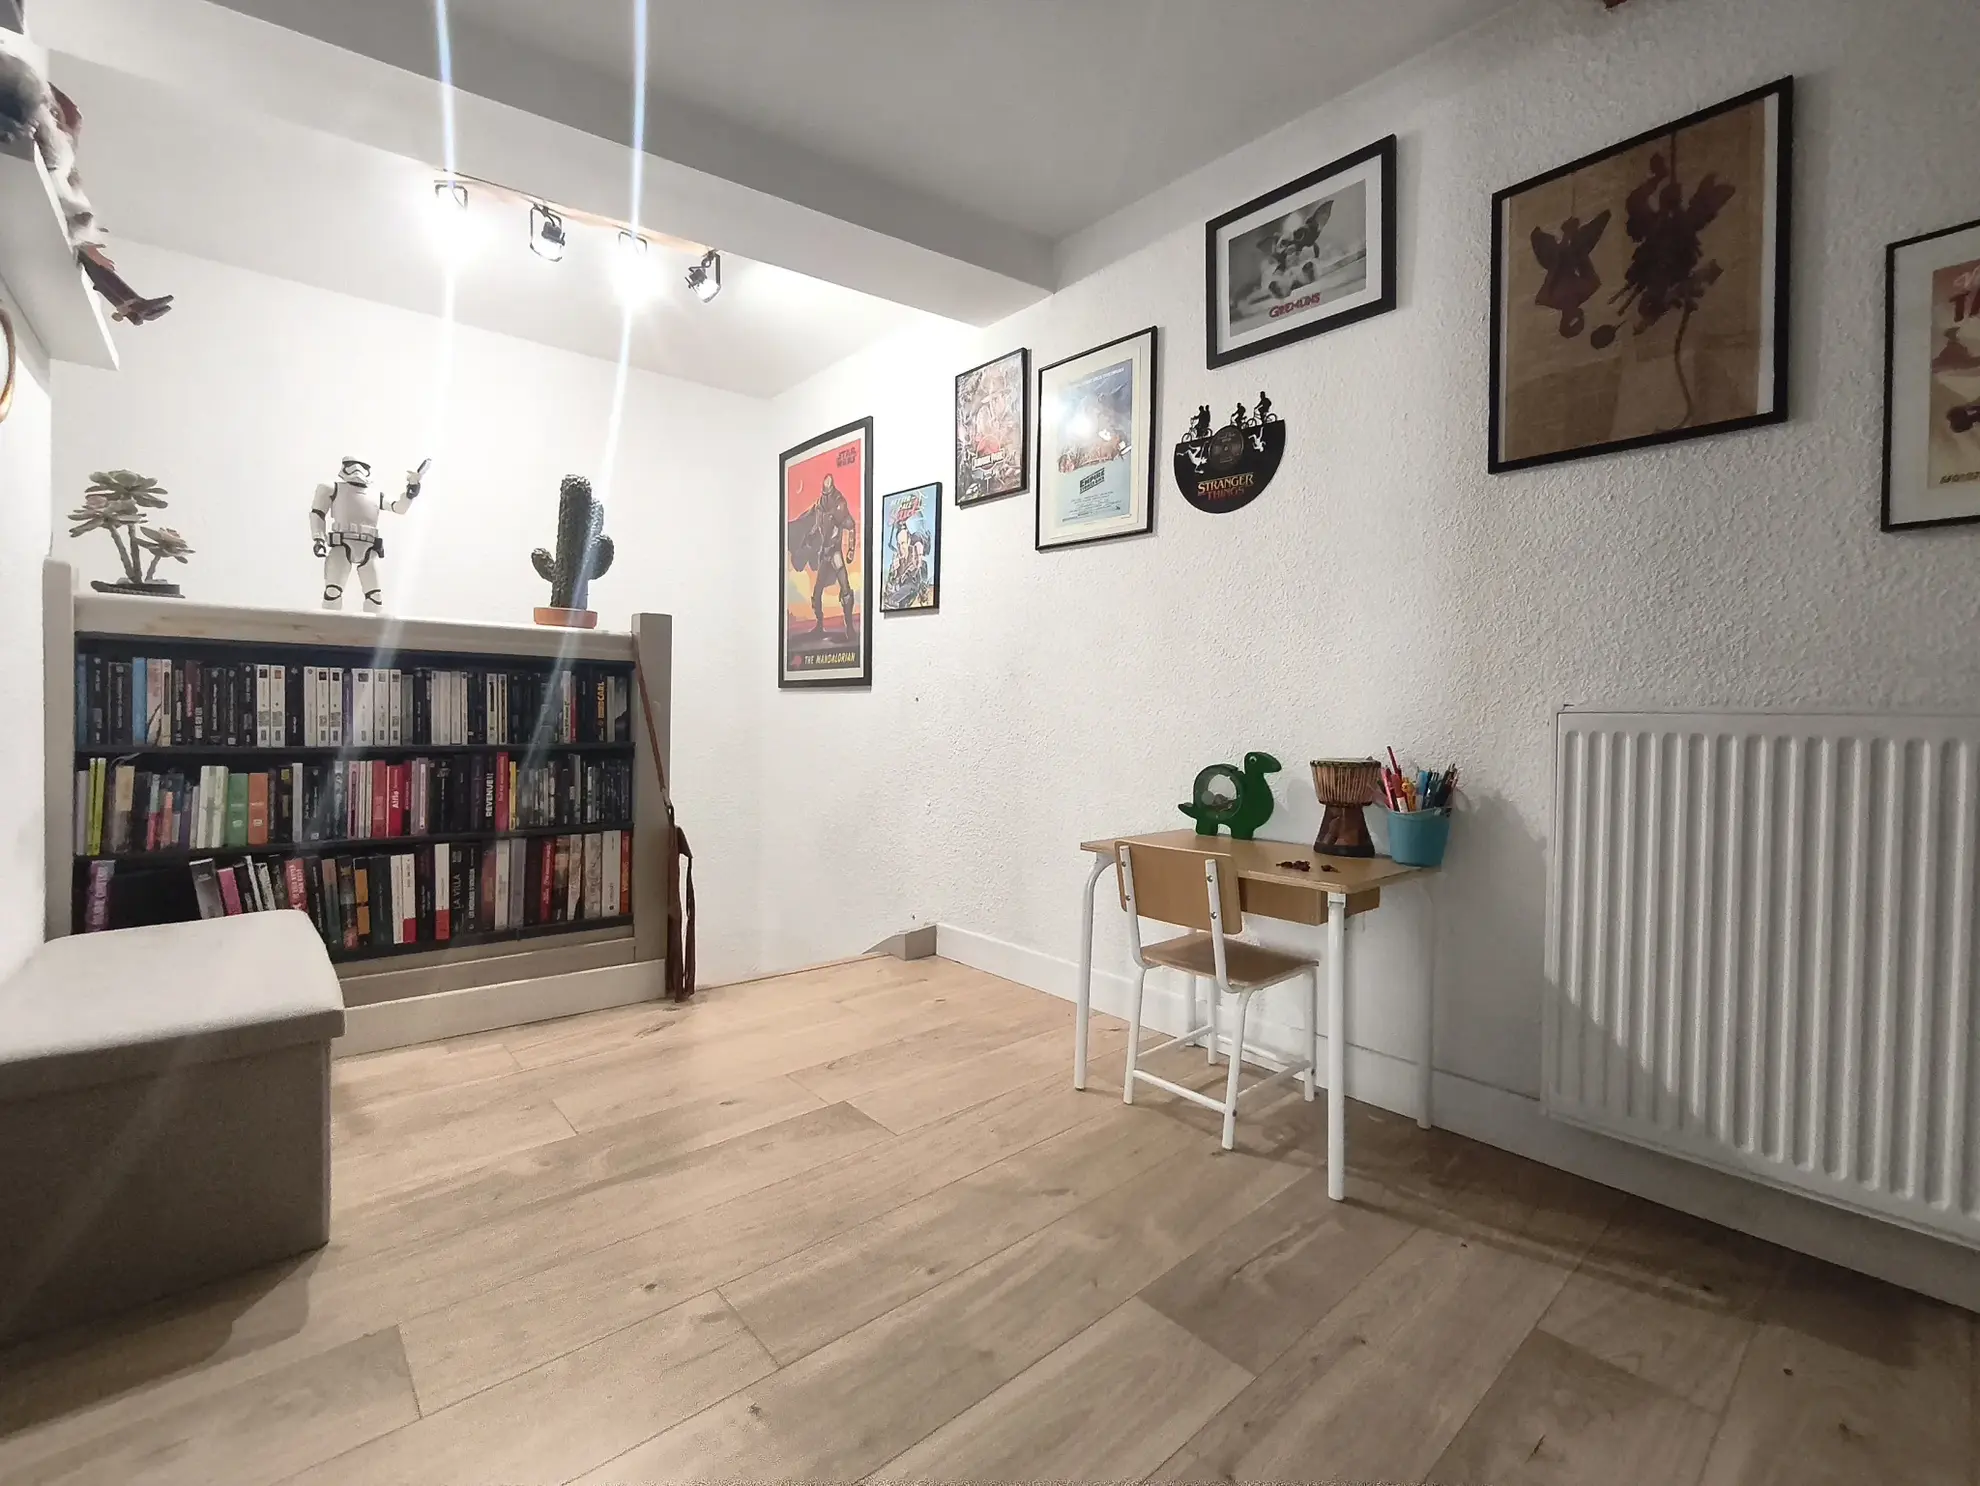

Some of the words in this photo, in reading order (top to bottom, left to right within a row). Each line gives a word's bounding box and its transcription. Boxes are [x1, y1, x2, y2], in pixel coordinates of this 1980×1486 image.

[1269, 292, 1321, 317] GREMLINS
[1198, 473, 1254, 494] STRANGER
[1208, 487, 1245, 500] THINGS
[804, 655, 814, 665] THE
[816, 651, 856, 664] MANDALORIAN
[453, 873, 461, 896] VILLA
[452, 898, 461, 909] LA
